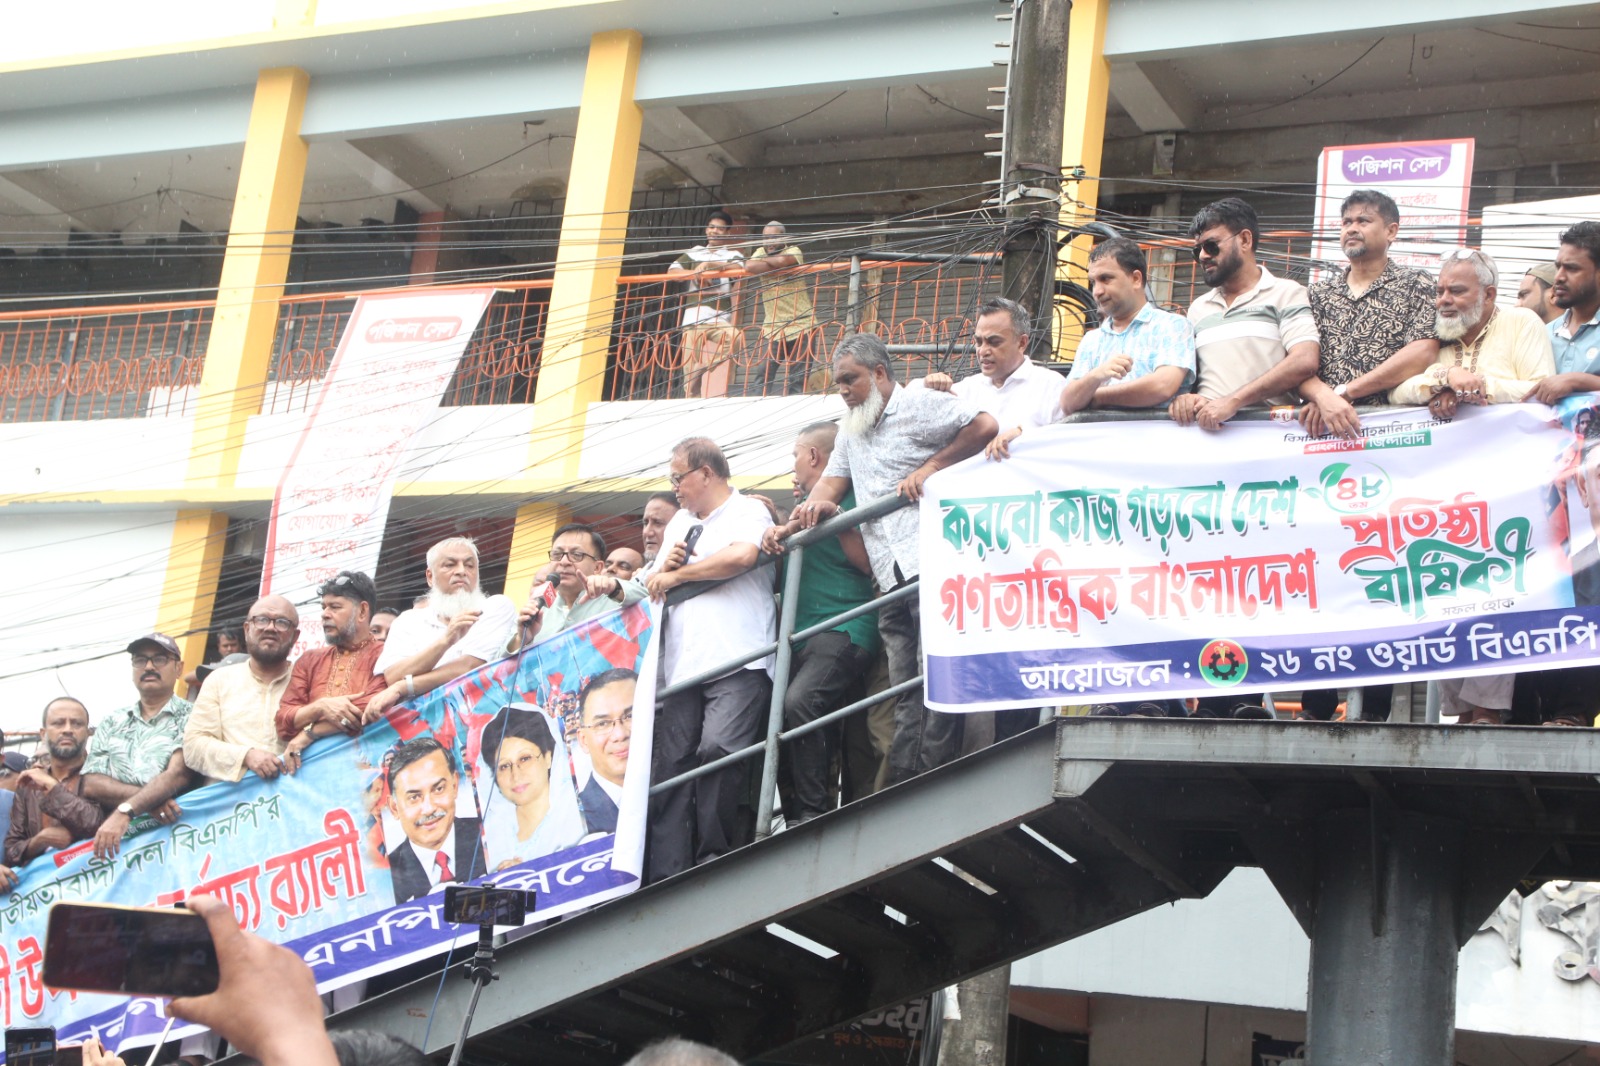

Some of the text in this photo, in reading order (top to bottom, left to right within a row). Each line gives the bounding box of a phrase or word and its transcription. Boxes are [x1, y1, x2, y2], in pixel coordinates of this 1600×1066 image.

[1348, 155, 1444, 176] পজিশন সেল
[368, 319, 457, 340] পজিশন সেল
[1309, 432, 1426, 451] বাংলাদেশ জিন্দাবাদ
[1337, 477, 1384, 500] ৪৮
[287, 513, 349, 533] যোগাযোগ
[940, 476, 1299, 558] করবো কাজ গড়বো দেশ
[1338, 491, 1491, 571] প্রতিষ্ঠা
[940, 548, 1318, 635] গণতান্ত্রিক বাংলাদেশ
[1353, 516, 1534, 619] বার্ষিকী
[1442, 597, 1515, 616] সফল হোক
[1019, 658, 1171, 692] আয়োজনে
[1260, 650, 1301, 677] ২৬
[1311, 645, 1356, 672] নং
[1366, 623, 1457, 671] ওয়ার্ড
[1467, 614, 1598, 661] বিএনপি
[0, 855, 117, 934] তীয়তাবাদী
[123, 840, 165, 872] দল
